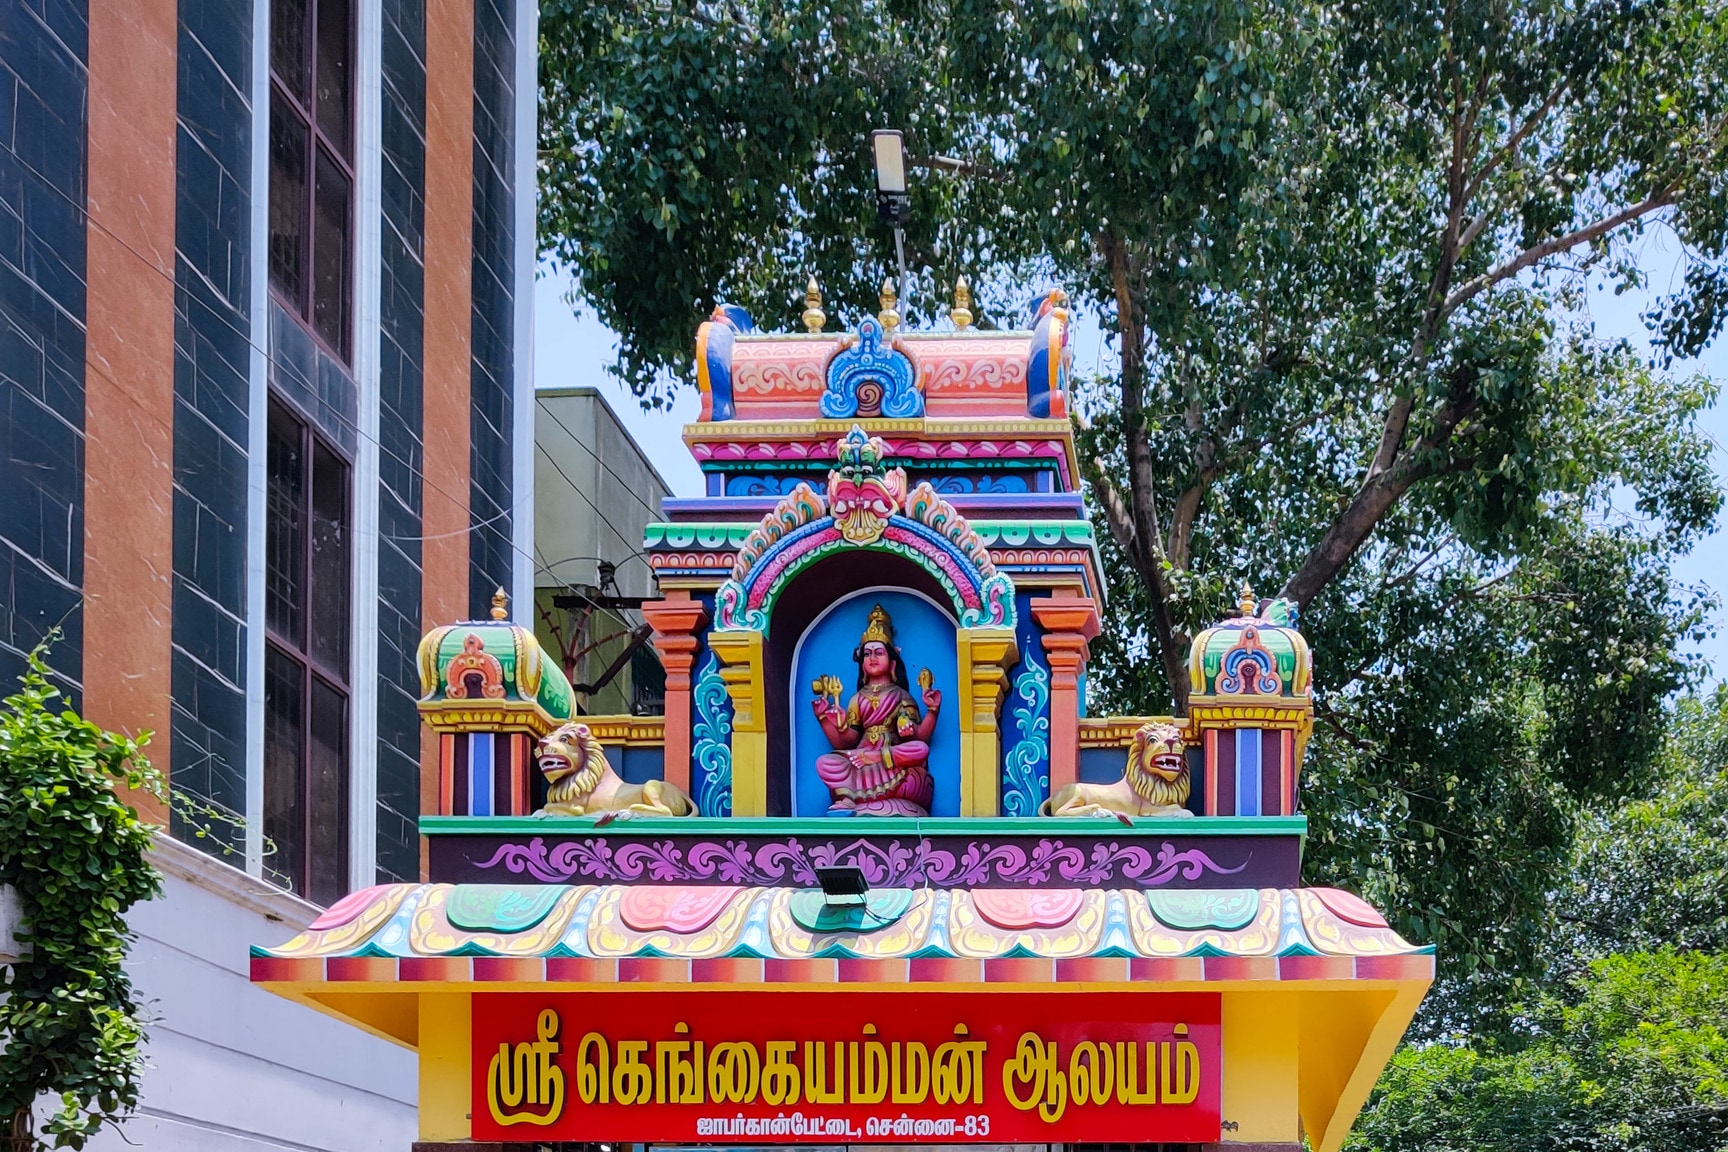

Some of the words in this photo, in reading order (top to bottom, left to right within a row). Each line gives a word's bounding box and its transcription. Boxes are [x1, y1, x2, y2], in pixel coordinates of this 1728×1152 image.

[487, 1008, 564, 1126] ஸ்ரீ
[576, 1021, 987, 1106] கெங்கையம்மன்
[1002, 1022, 1201, 1123] ஆலயம்
